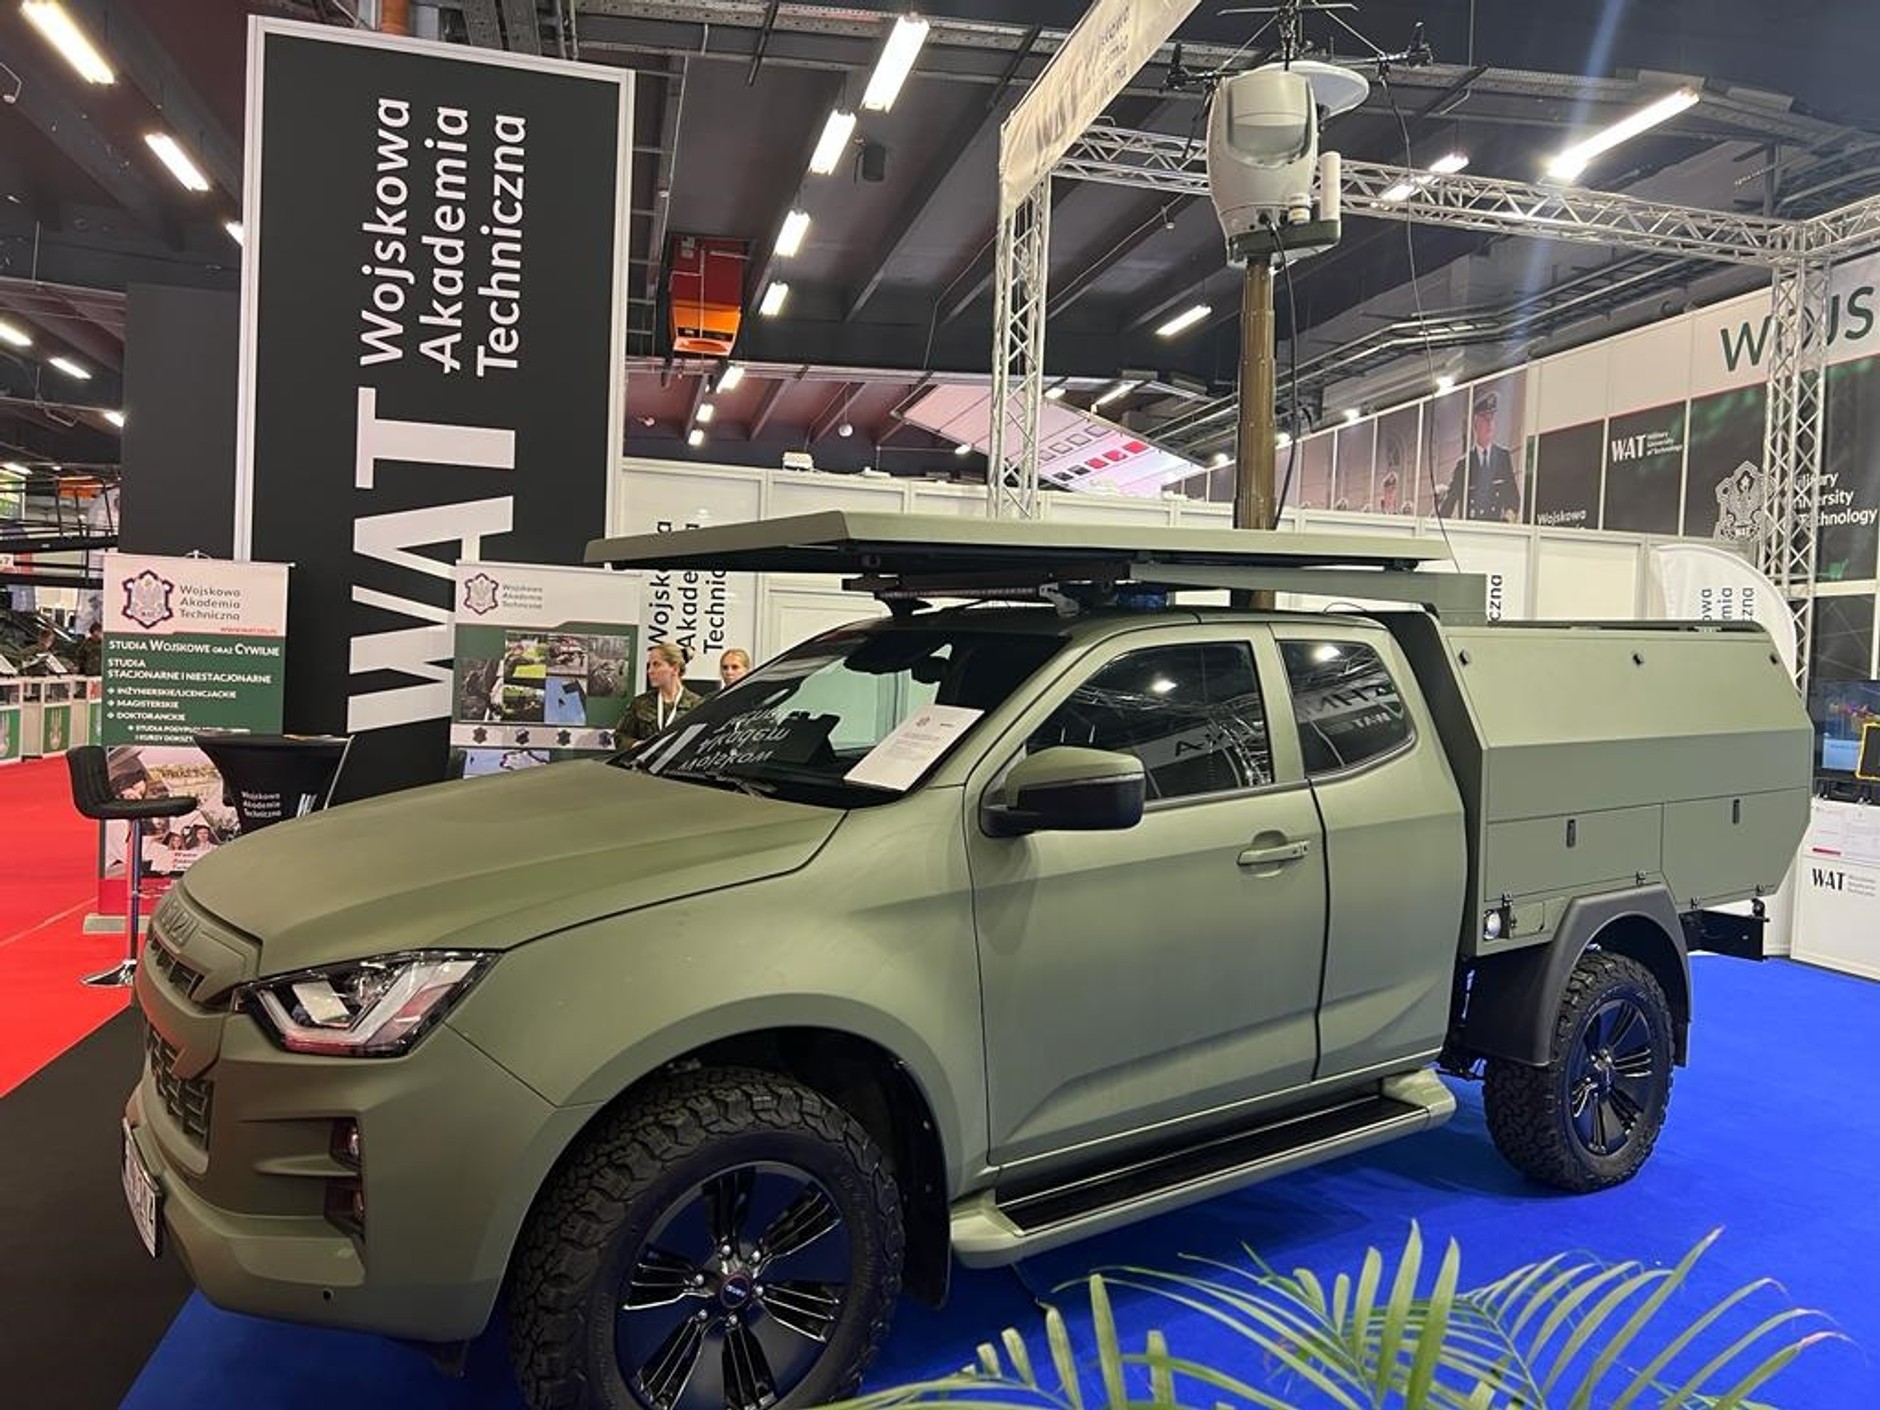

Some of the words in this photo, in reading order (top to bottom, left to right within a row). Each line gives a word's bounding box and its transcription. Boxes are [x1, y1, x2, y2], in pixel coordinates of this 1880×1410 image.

[359, 97, 416, 366] Wojskowa
[418, 106, 469, 374] Akademia
[476, 114, 527, 377] Techniczna
[1612, 434, 1646, 462] WAT
[347, 386, 515, 733] WAT
[180, 585, 241, 598] Wojskowa
[180, 598, 240, 609] Akademia
[180, 610, 240, 621] Techniczna
[109, 640, 148, 651] STUDIA
[108, 658, 146, 668] STUDIA
[108, 670, 179, 681] STACJONARNE
[185, 673, 272, 684] NIESTACJONARNE
[1812, 868, 1845, 891] WAT
